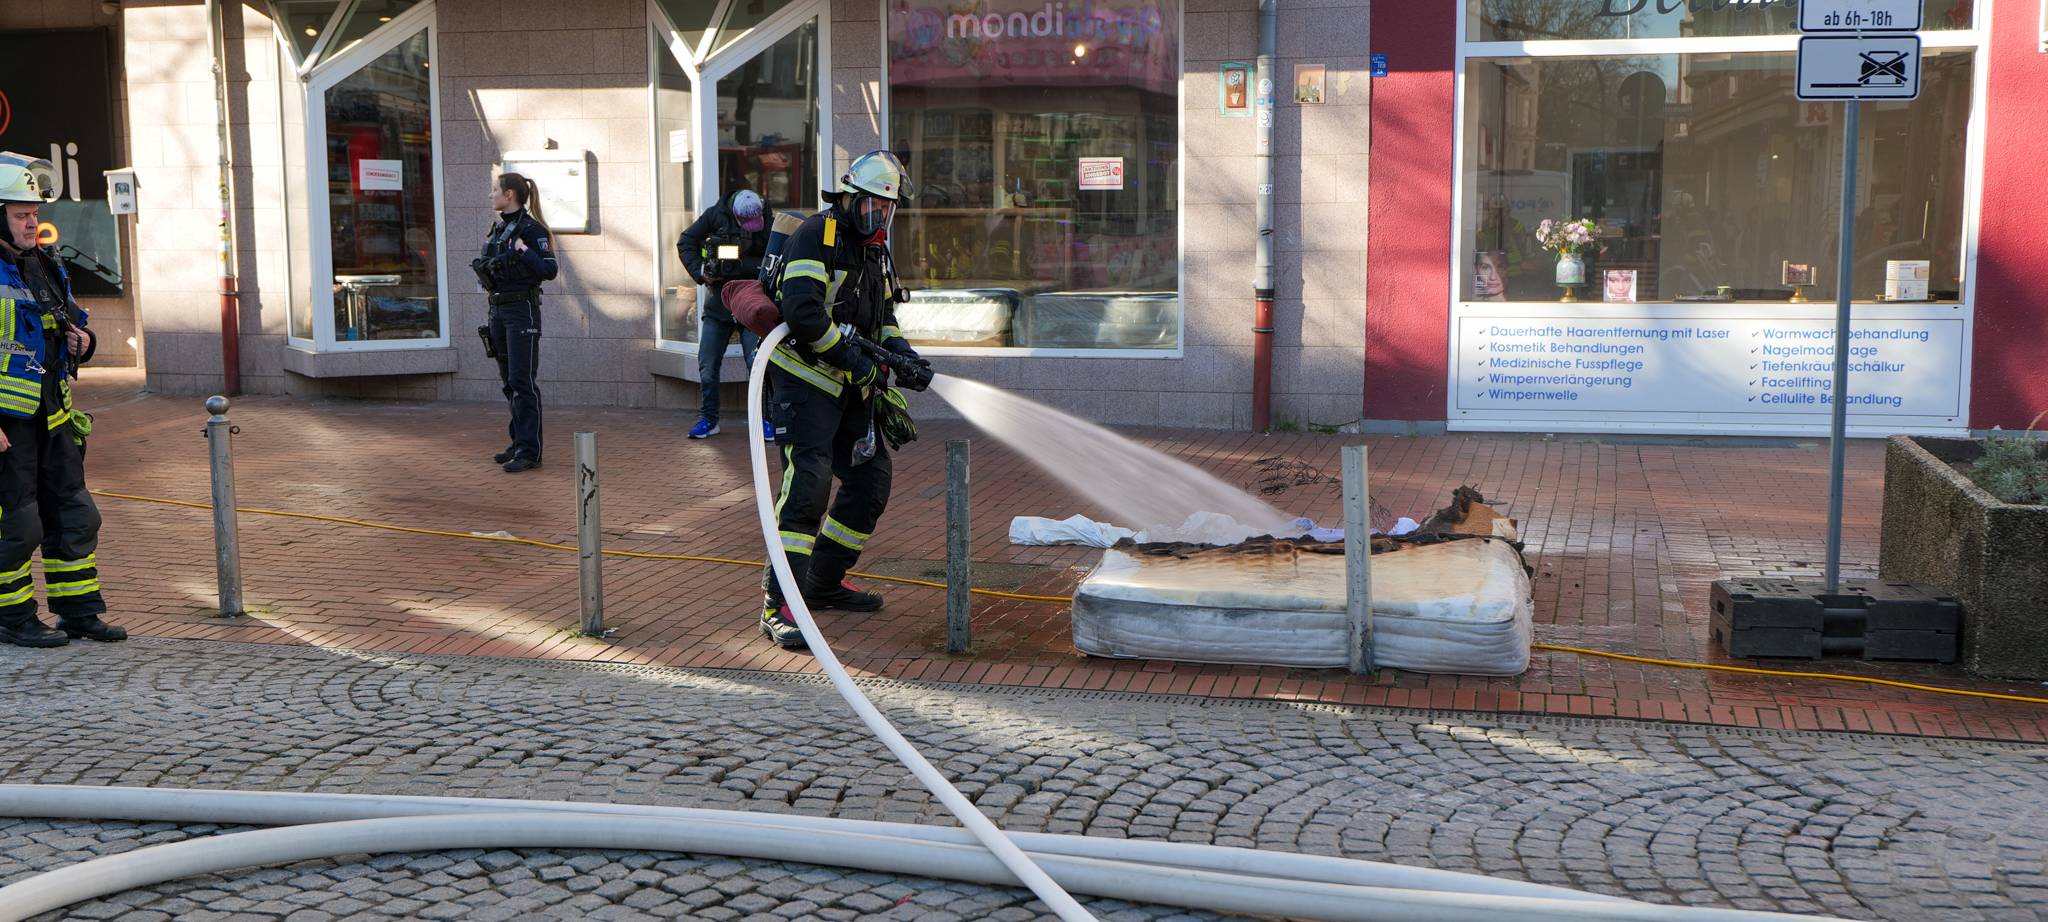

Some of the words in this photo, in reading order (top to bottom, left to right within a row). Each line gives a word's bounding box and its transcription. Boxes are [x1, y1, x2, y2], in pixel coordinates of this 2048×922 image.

[1823, 10, 1840, 26] ab
[24, 172, 35, 185] 2
[1490, 326, 1562, 337] Dauerhafte
[1567, 326, 1668, 340] Haarentfernung
[1672, 327, 1692, 339] mit
[1697, 328, 1730, 339] Laser
[1763, 328, 1929, 342] Warmwachehandlung
[1490, 342, 1546, 353] Kosmetik
[1550, 342, 1644, 356] Behandlungen
[1762, 344, 1878, 358] Nagelmodage
[1489, 357, 1571, 369] Medizinische
[1575, 358, 1643, 372] Fusspflege
[1762, 360, 1905, 372] Tiefenkräutschälkur
[1489, 373, 1632, 388] Wimpernverlängerung
[1761, 376, 1831, 390] Facelifting
[1488, 389, 1578, 402] Wimpernwelle
[1761, 393, 1815, 404] Cellulite
[1820, 393, 1902, 407] Beandlung
